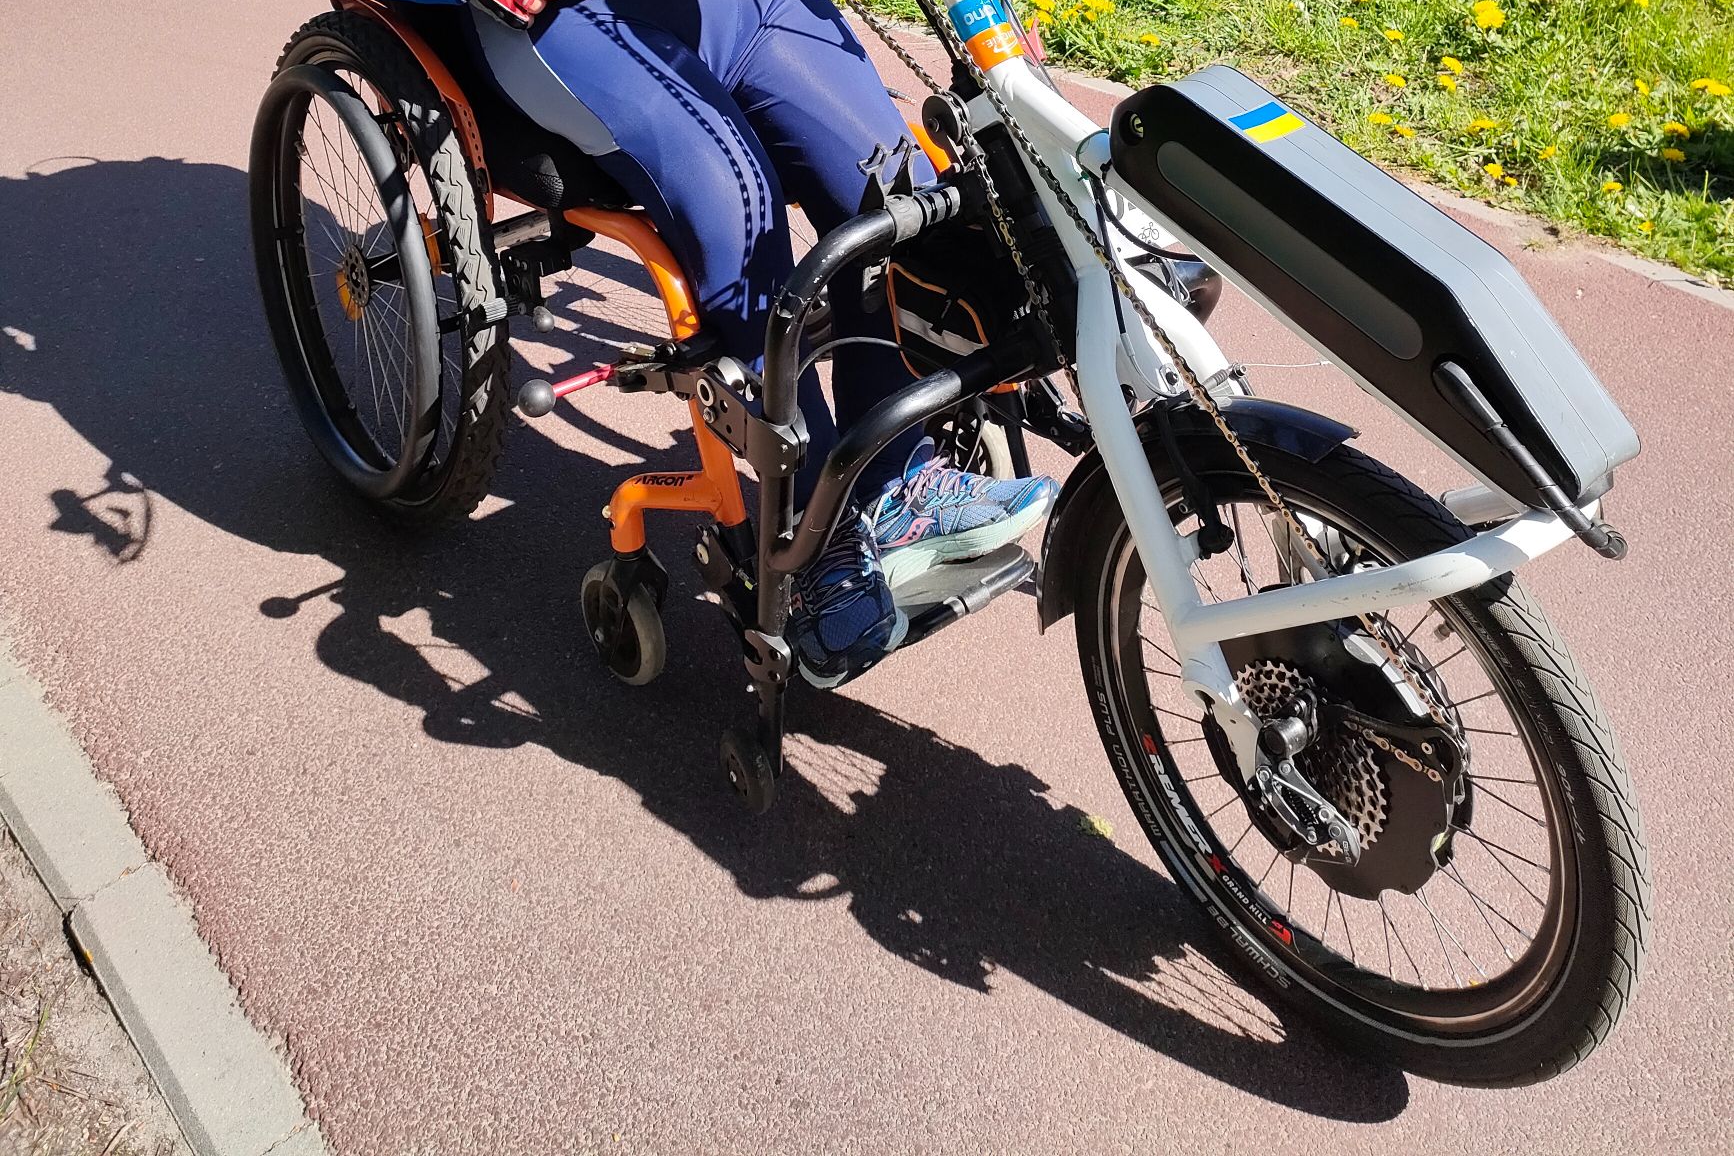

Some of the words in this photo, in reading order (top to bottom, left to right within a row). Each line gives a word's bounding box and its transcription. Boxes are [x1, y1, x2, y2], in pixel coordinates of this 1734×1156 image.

[1097, 690, 1115, 736] PLUS
[1112, 743, 1162, 837] MARATHON
[1222, 874, 1250, 905] GRAND
[1249, 904, 1268, 925] HILL
[1206, 904, 1292, 989] SCHWALBE
